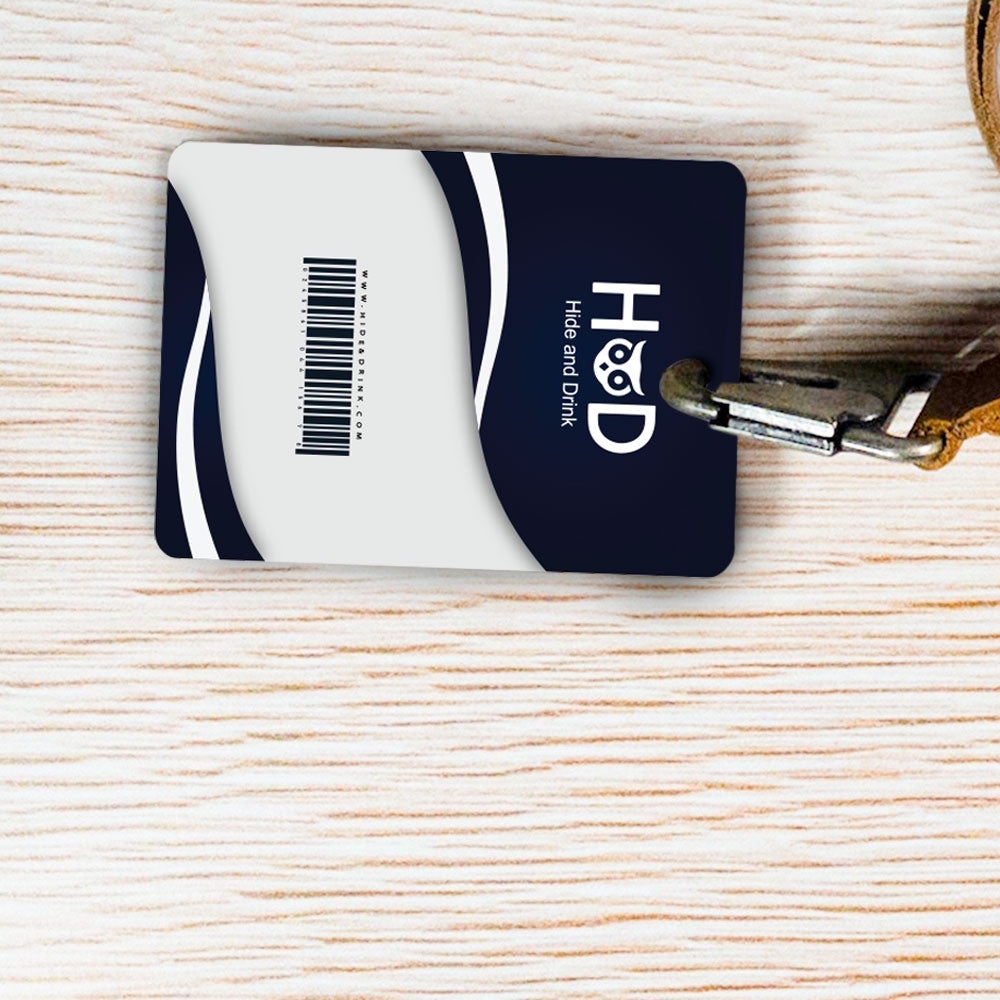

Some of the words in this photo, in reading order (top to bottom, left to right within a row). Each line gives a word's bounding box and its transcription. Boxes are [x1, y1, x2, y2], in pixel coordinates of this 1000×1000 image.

[563, 300, 582, 339] Hide
[562, 344, 579, 377] and
[560, 382, 579, 427] Drink
